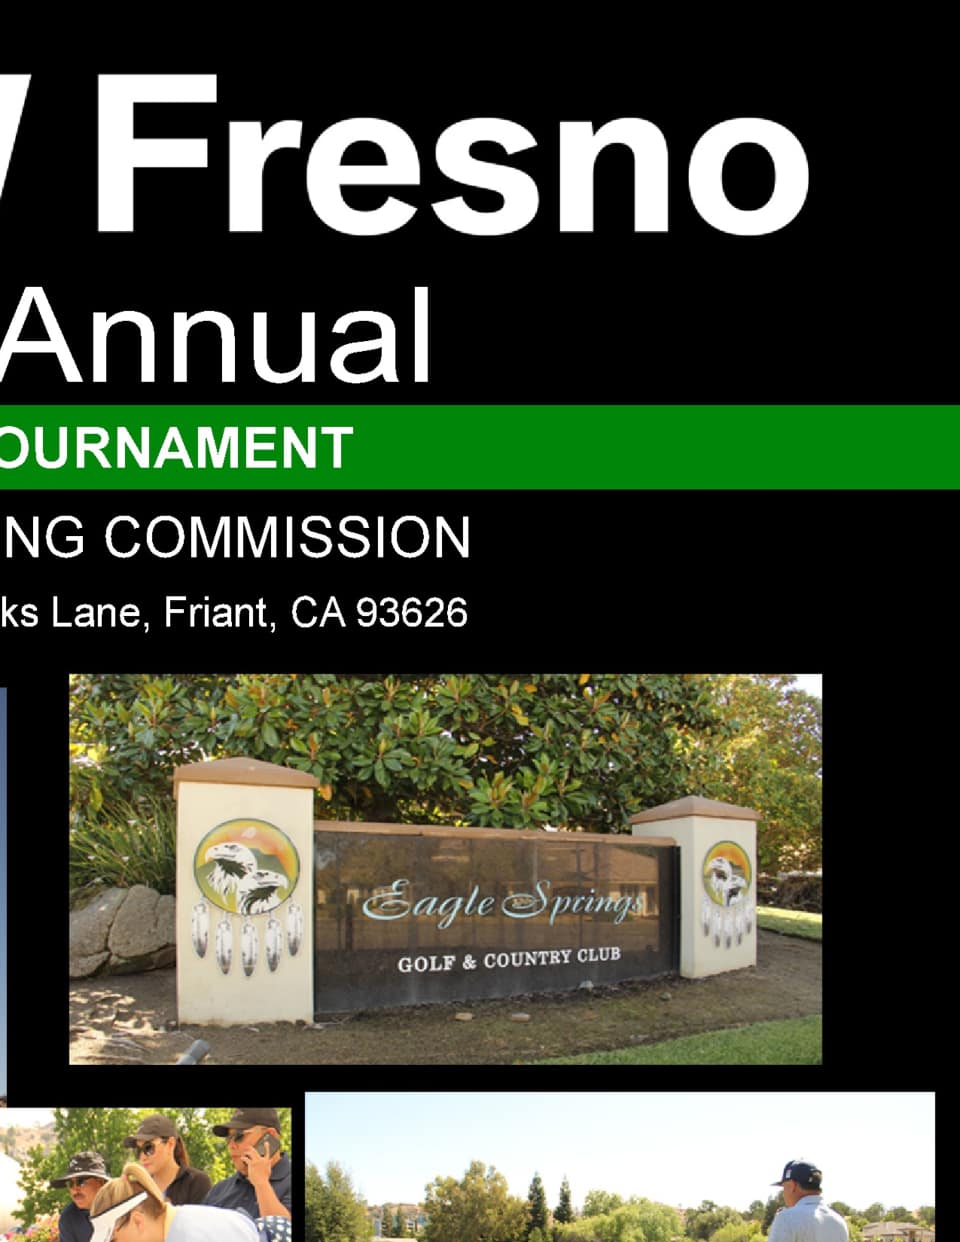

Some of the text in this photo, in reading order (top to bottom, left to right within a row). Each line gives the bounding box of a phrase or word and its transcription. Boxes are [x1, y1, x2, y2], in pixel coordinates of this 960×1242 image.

[362, 878, 645, 930] Eagle Springs
[397, 947, 622, 973] GOLF & COUNTRY CLUB
